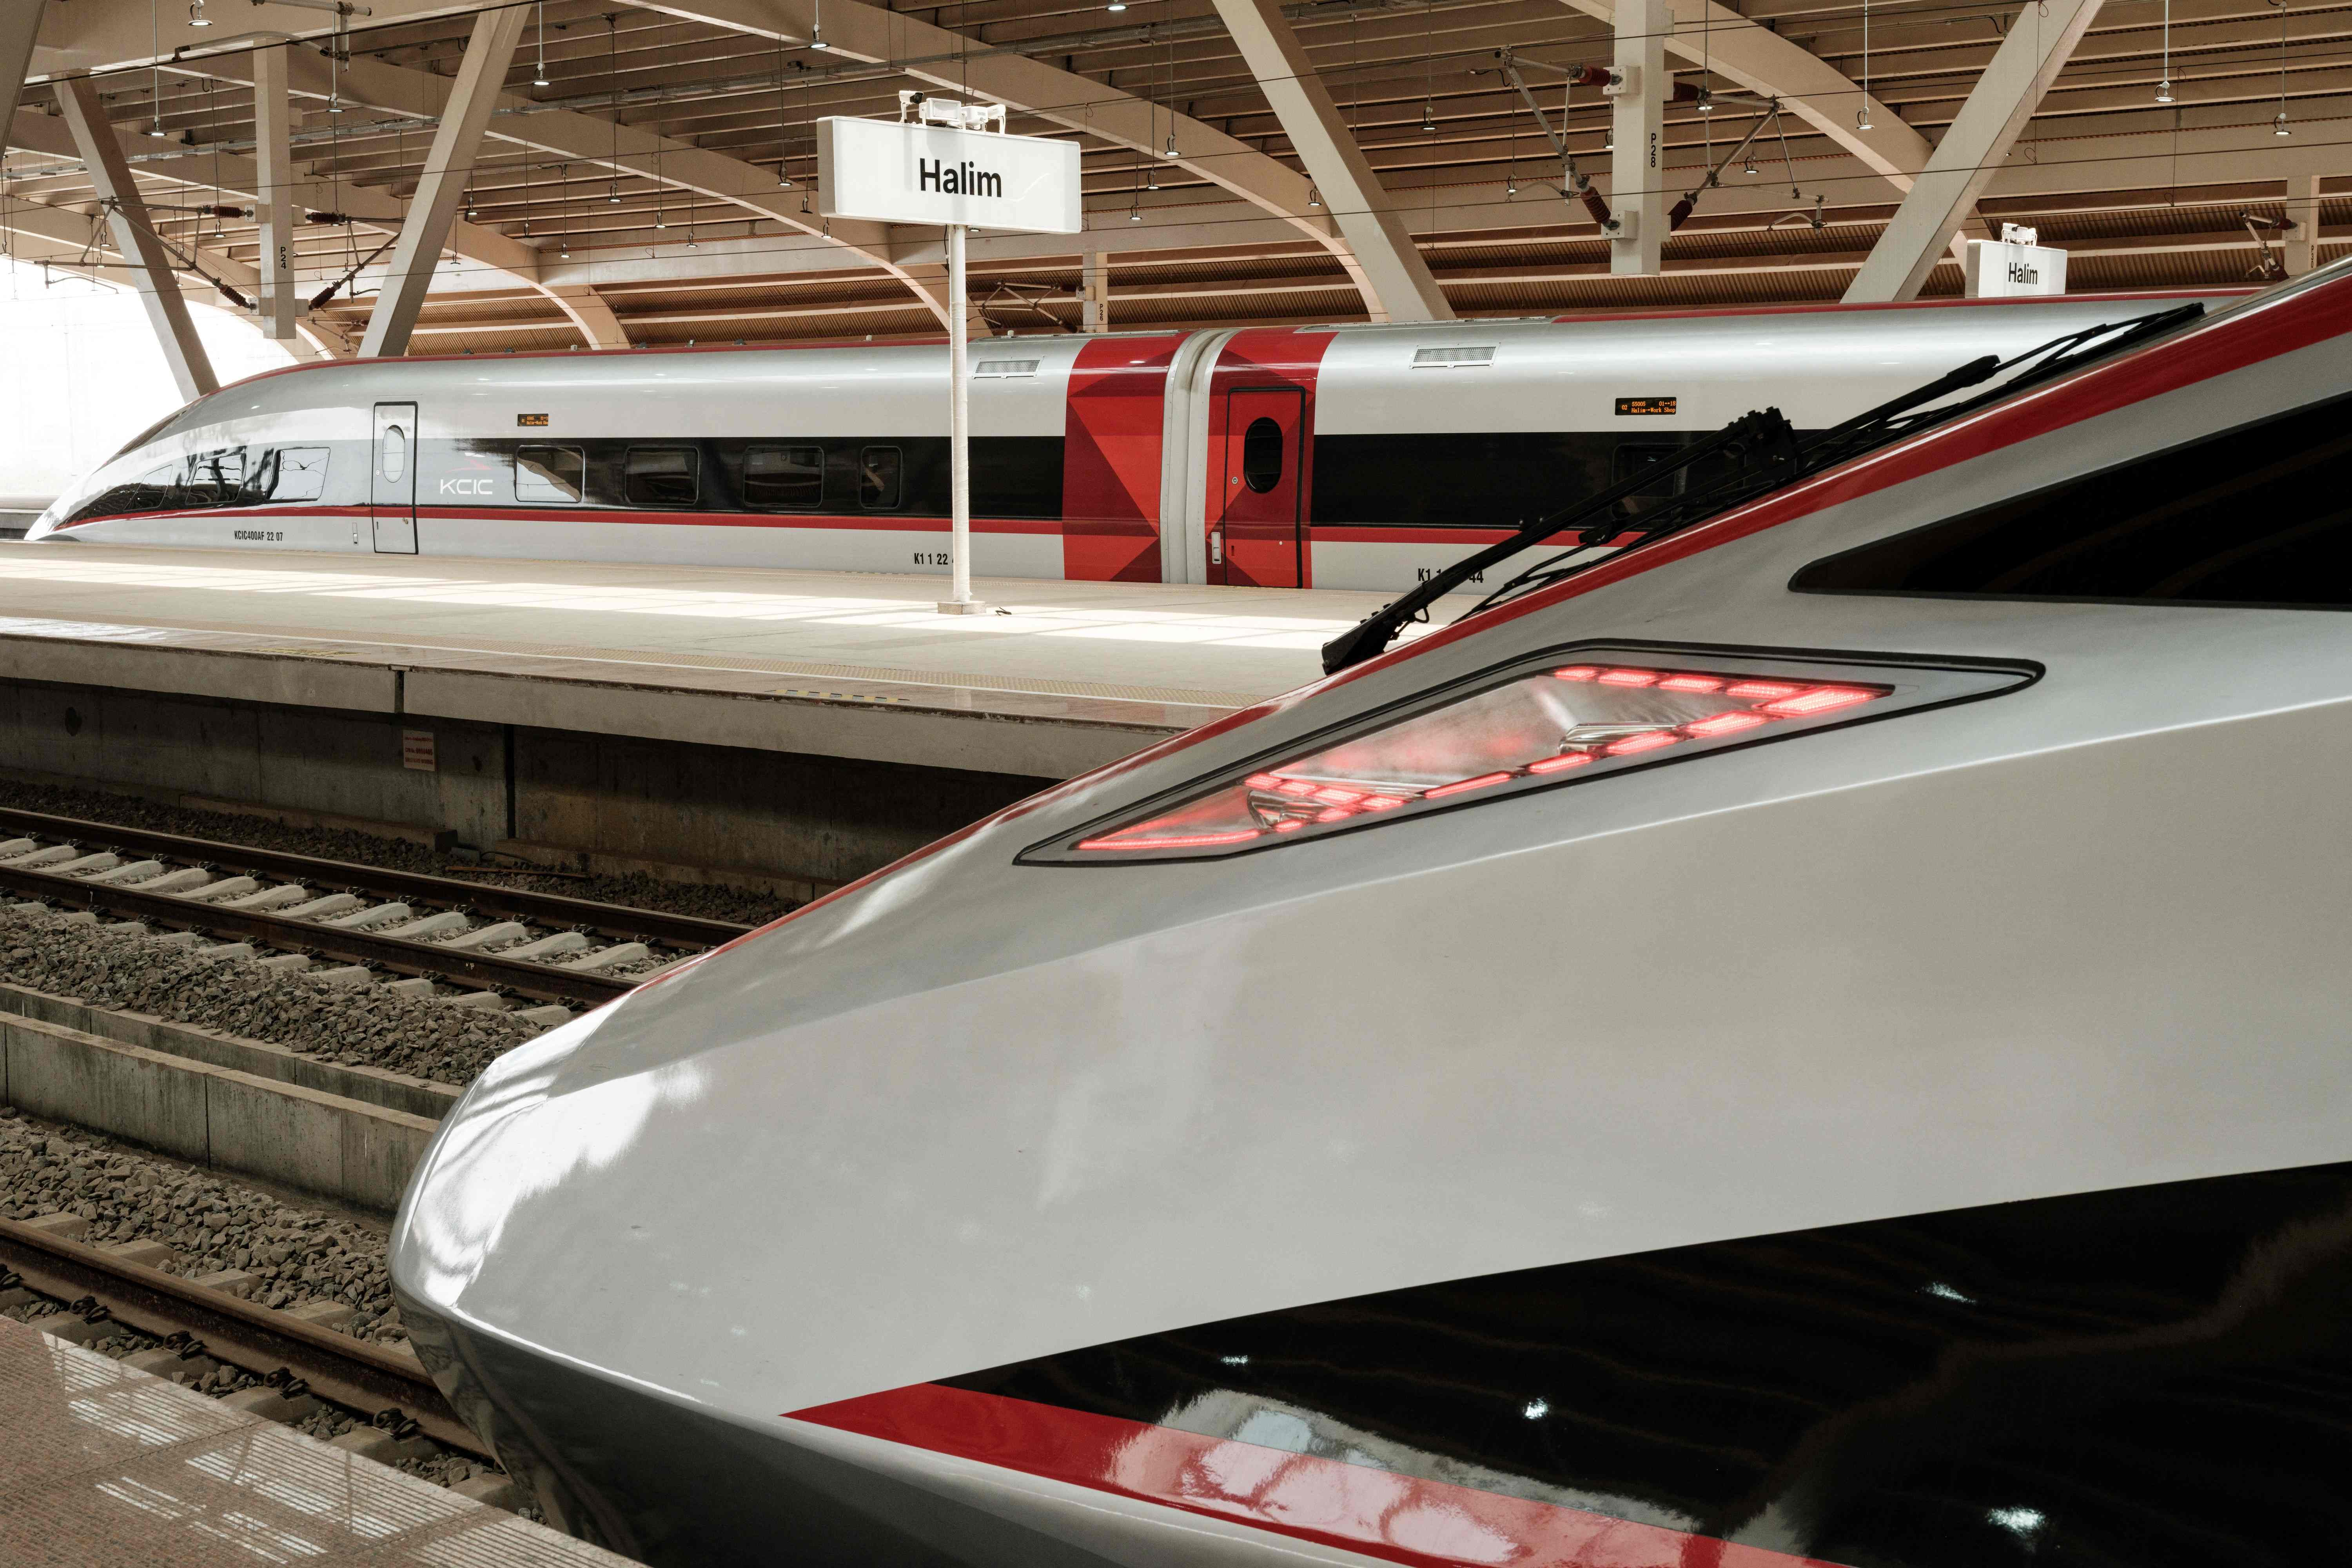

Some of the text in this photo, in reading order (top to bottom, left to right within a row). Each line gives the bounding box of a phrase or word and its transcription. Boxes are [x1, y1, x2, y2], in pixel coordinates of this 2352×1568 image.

[920, 158, 1002, 198] Halim
[2008, 262, 2038, 285] Halim
[440, 479, 493, 495] KCIC
[234, 530, 283, 541] KCIC400AF 22 07
[914, 553, 924, 564] K1
[928, 553, 932, 565] 1
[936, 553, 948, 565] 22
[1418, 568, 1430, 581] K1
